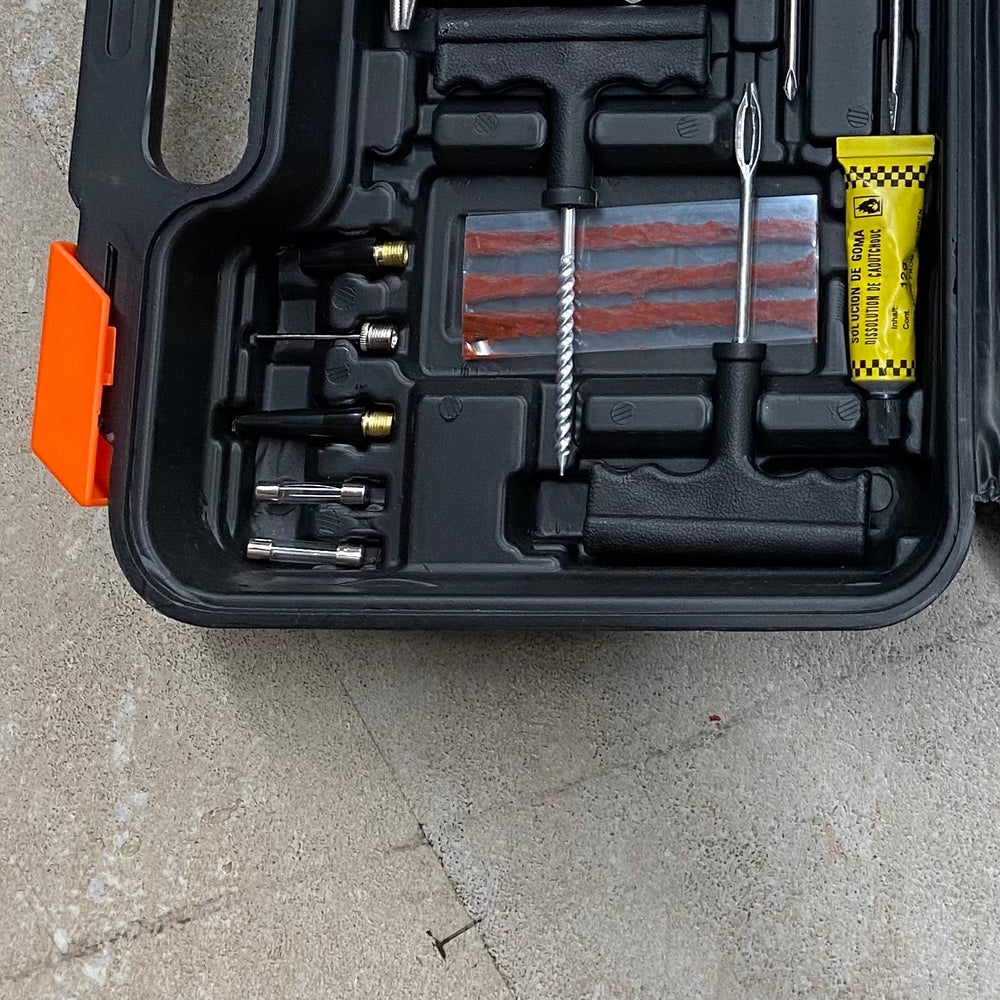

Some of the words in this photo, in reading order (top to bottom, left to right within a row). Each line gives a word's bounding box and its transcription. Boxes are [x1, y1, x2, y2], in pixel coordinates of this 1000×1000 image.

[851, 229, 865, 262] GOMA
[867, 228, 882, 277] CAOUTCHOUC
[851, 267, 862, 281] DE
[867, 282, 881, 291] DE
[865, 295, 880, 345] DISSOLUTION
